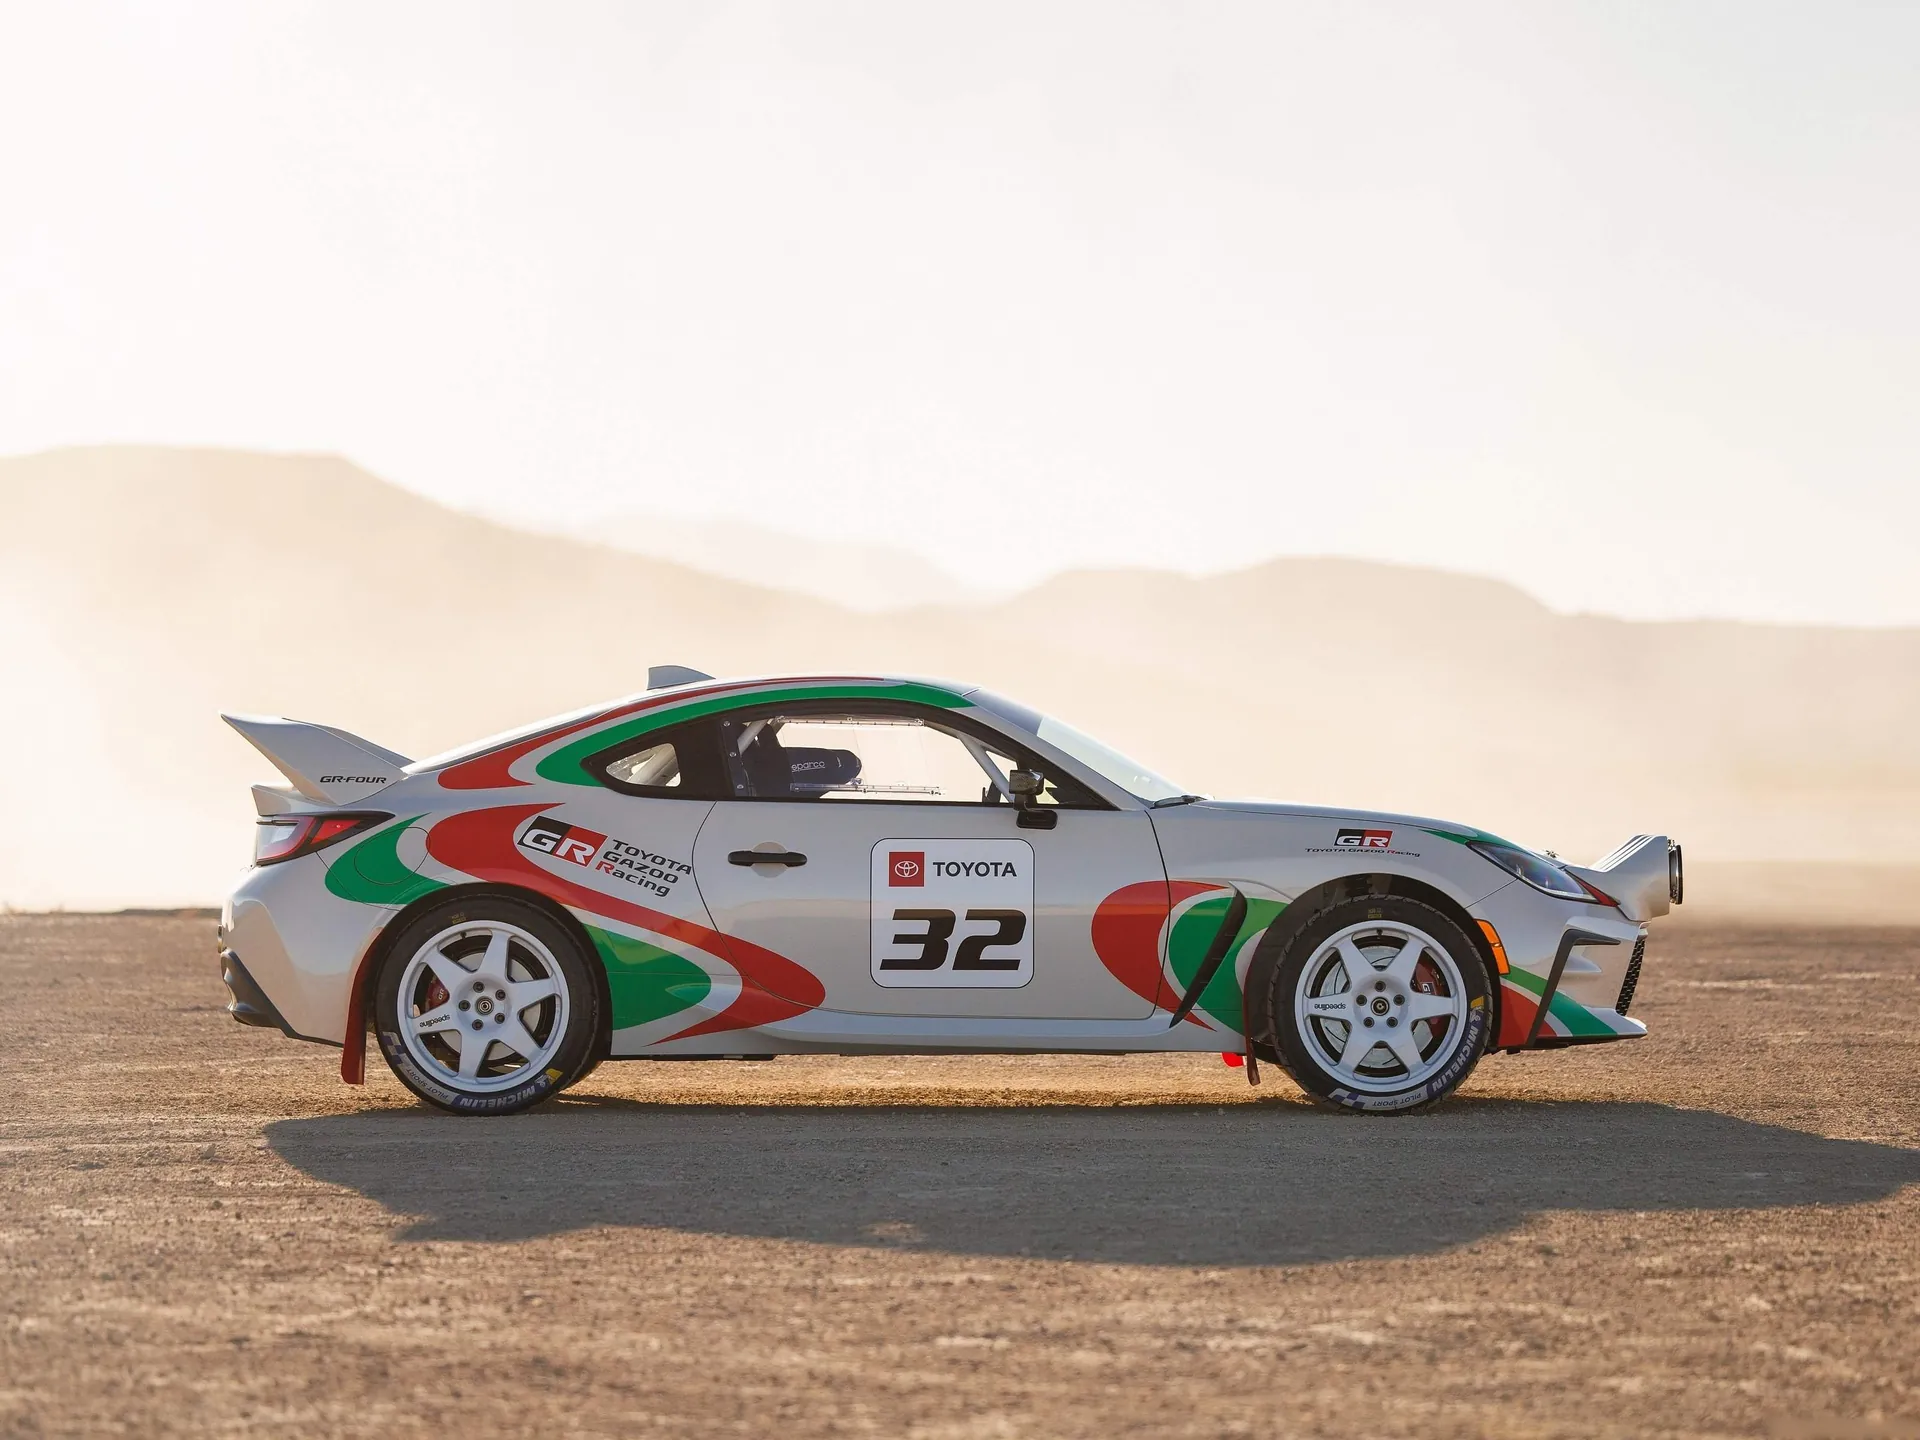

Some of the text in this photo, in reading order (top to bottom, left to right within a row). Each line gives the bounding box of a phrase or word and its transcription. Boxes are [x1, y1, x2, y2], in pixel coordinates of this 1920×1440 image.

[791, 761, 825, 773] sparco
[522, 828, 595, 864] GR
[1336, 835, 1389, 847] GR
[612, 839, 692, 875] TOYOTA
[1387, 849, 1421, 858] Racing
[595, 860, 671, 897] Racing
[602, 850, 679, 885] GAZOO
[932, 861, 1017, 877] TOYOTA
[879, 908, 1027, 971] 32
[1314, 1002, 1346, 1011] speedline
[419, 1014, 450, 1028] speedline
[1432, 1025, 1479, 1092] MICHELIN
[406, 1068, 449, 1100] PILOT SPORT
[460, 1085, 535, 1108] MICHELIN
[1372, 1093, 1422, 1107] PILOT SPORT
